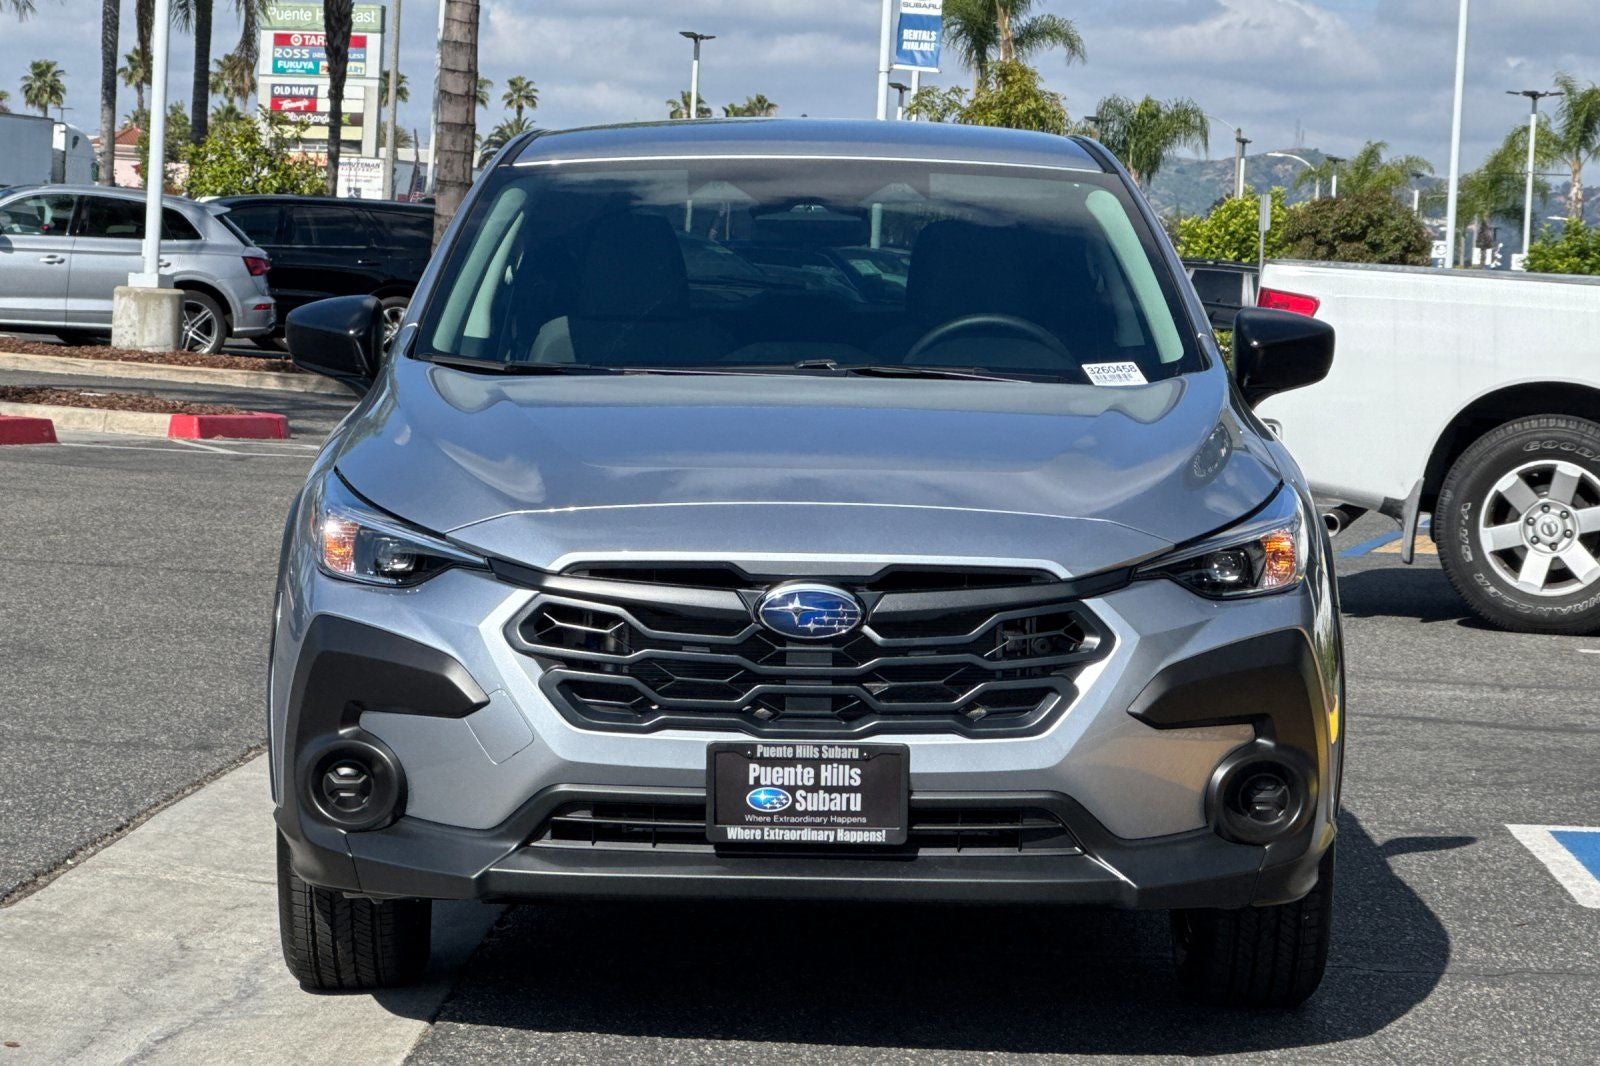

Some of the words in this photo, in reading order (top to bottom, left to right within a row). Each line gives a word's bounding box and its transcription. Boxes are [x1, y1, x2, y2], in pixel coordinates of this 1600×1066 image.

[903, 29, 937, 41] RENTALS
[304, 36, 327, 46] TAR
[902, 41, 935, 51] AVAILABLE
[274, 48, 309, 59] ROSS
[277, 60, 315, 69] FUKUYA
[273, 86, 291, 95] OLD
[292, 87, 315, 96] NAVY
[1087, 364, 1138, 375] 3260458
[756, 744, 793, 759] Puente
[795, 744, 819, 759] Hills
[821, 745, 859, 759] Subaru
[748, 763, 815, 786] Puente
[820, 763, 861, 787] Hills
[795, 789, 861, 811] Subaru
[744, 814, 772, 823] Where
[773, 814, 828, 824] Extraordinary
[830, 815, 867, 824] Happens
[726, 826, 762, 840] Where
[763, 827, 835, 843] Extraordinary
[836, 828, 886, 843] Happens!
